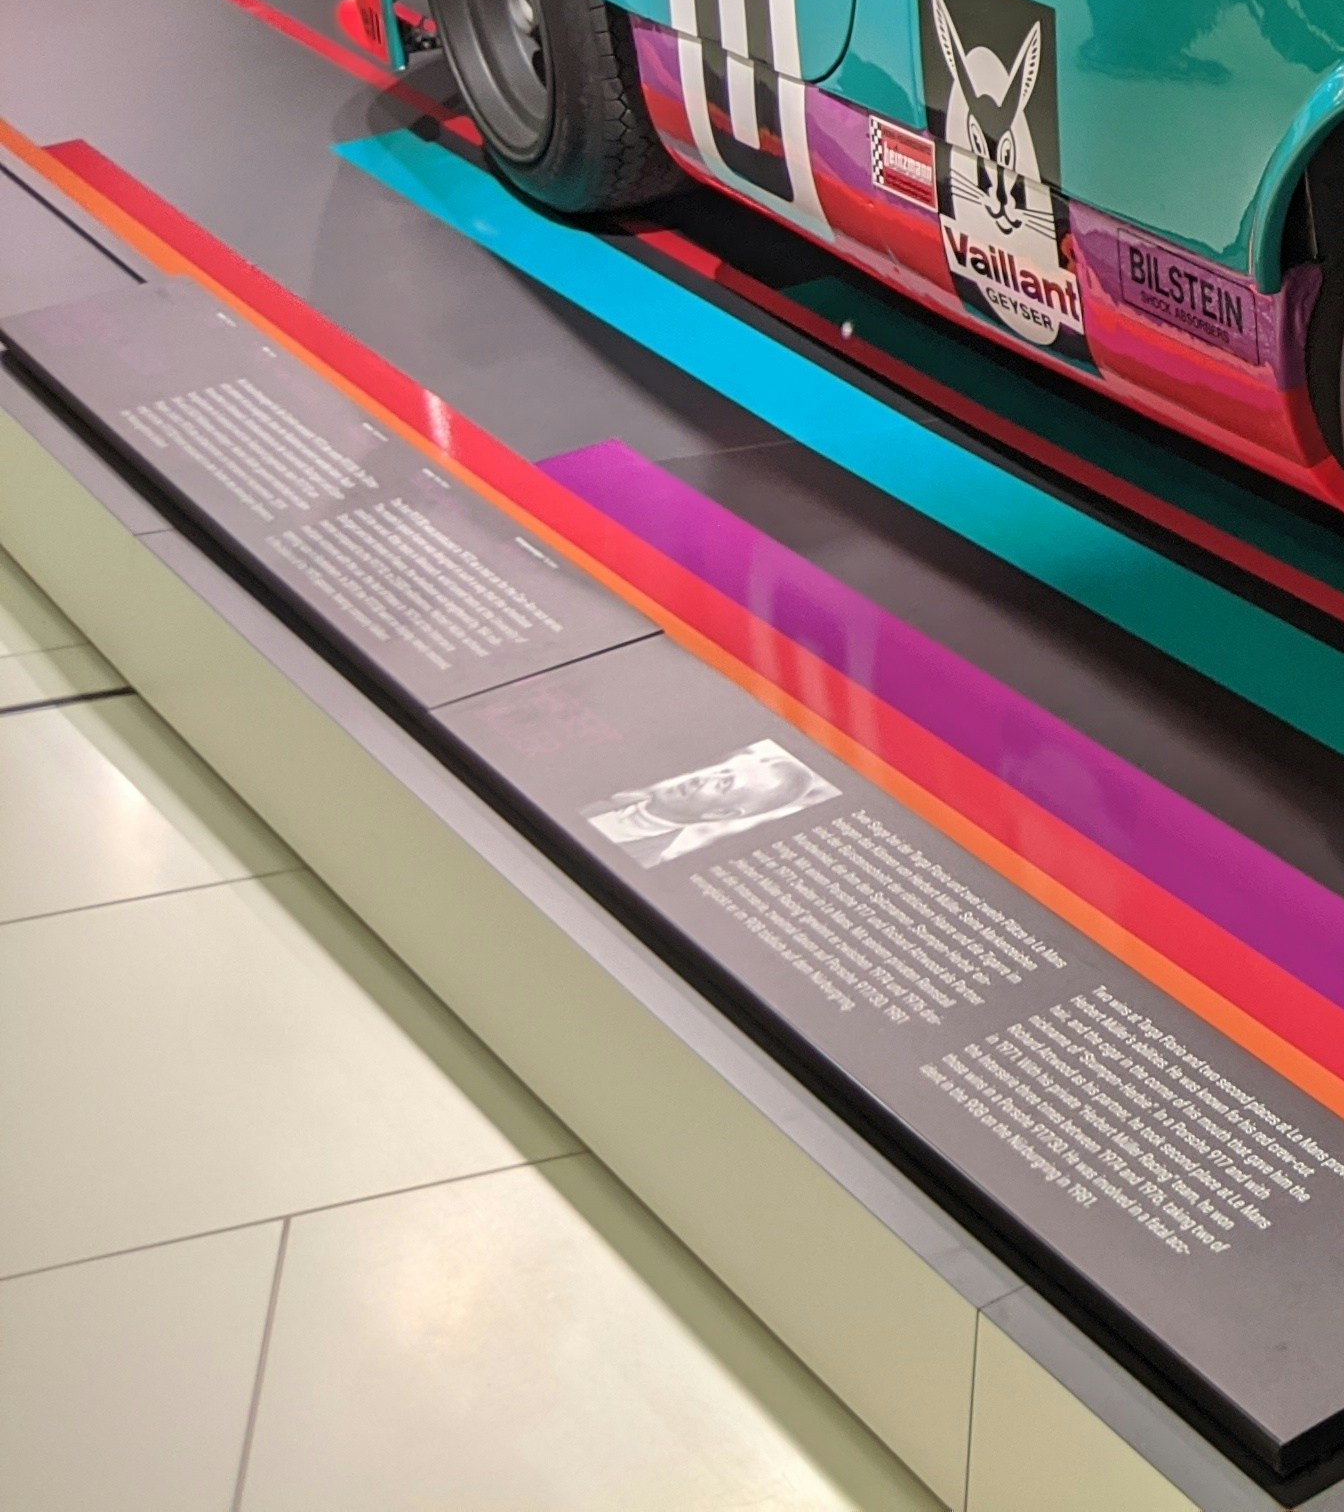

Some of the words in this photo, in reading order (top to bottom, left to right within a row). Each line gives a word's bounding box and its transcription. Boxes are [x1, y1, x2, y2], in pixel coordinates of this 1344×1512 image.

[944, 226, 1081, 321] Vaillant
[1129, 247, 1244, 334] BILSTEIN
[985, 287, 1055, 332] GEYSER
[853, 902, 876, 917] 917
[1041, 948, 1067, 968] Mans
[1016, 1056, 1042, 1077] With
[1035, 1072, 1054, 1087] his
[1044, 1083, 1081, 1109] private
[1126, 1012, 1142, 1023] at
[1137, 1017, 1163, 1039] Targa
[1158, 1034, 1186, 1056] Florio
[1181, 1053, 1206, 1068] and
[1198, 1064, 1220, 1081] two
[1215, 1078, 1255, 1104] second
[1243, 1101, 1280, 1125] places
[1275, 1122, 1292, 1134] at
[1285, 1127, 1303, 1142] Le
[1298, 1137, 1329, 1161] Mans
[1083, 1030, 1103, 1045] the
[1098, 1042, 1125, 1060] cigar
[1118, 1056, 1133, 1068] in
[1128, 1064, 1148, 1079] the
[1143, 1076, 1177, 1100] corner
[1171, 1097, 1191, 1108] of
[1182, 1103, 1201, 1120] his
[1196, 1116, 1231, 1142] mouth
[1226, 1138, 1252, 1157] that
[1243, 1154, 1274, 1174] gave
[1269, 1169, 1293, 1189] him
[1288, 1184, 1310, 1202] the
[1164, 1064, 1183, 1079] He
[1178, 1075, 1201, 1092] was
[1195, 1087, 1229, 1114] known
[1224, 1109, 1243, 1123] for
[1237, 1118, 1256, 1134] his
[1251, 1131, 1276, 1146] red
[1267, 1142, 1314, 1177] crew-cut
[1070, 1074, 1086, 1086] as
[1081, 1080, 1100, 1096] his
[1091, 1092, 1131, 1122] partner,
[1127, 1116, 1144, 1130] he
[1139, 1126, 1165, 1146] took
[1159, 1143, 1200, 1171] second
[1188, 1167, 1221, 1190] place
[1216, 1187, 1233, 1199] at
[1226, 1193, 1245, 1209] Le
[1239, 1203, 1271, 1229] Mans
[1111, 1131, 1144, 1156] Müller
[1152, 1108, 1167, 1121] In
[1169, 1121, 1210, 1154] Porsche
[1206, 1149, 1233, 1167] 917
[1224, 1165, 1252, 1183] and
[1243, 1179, 1270, 1200] with
[1171, 1179, 1199, 1205] team,
[1196, 1198, 1214, 1213] he
[1209, 1210, 1234, 1230] won
